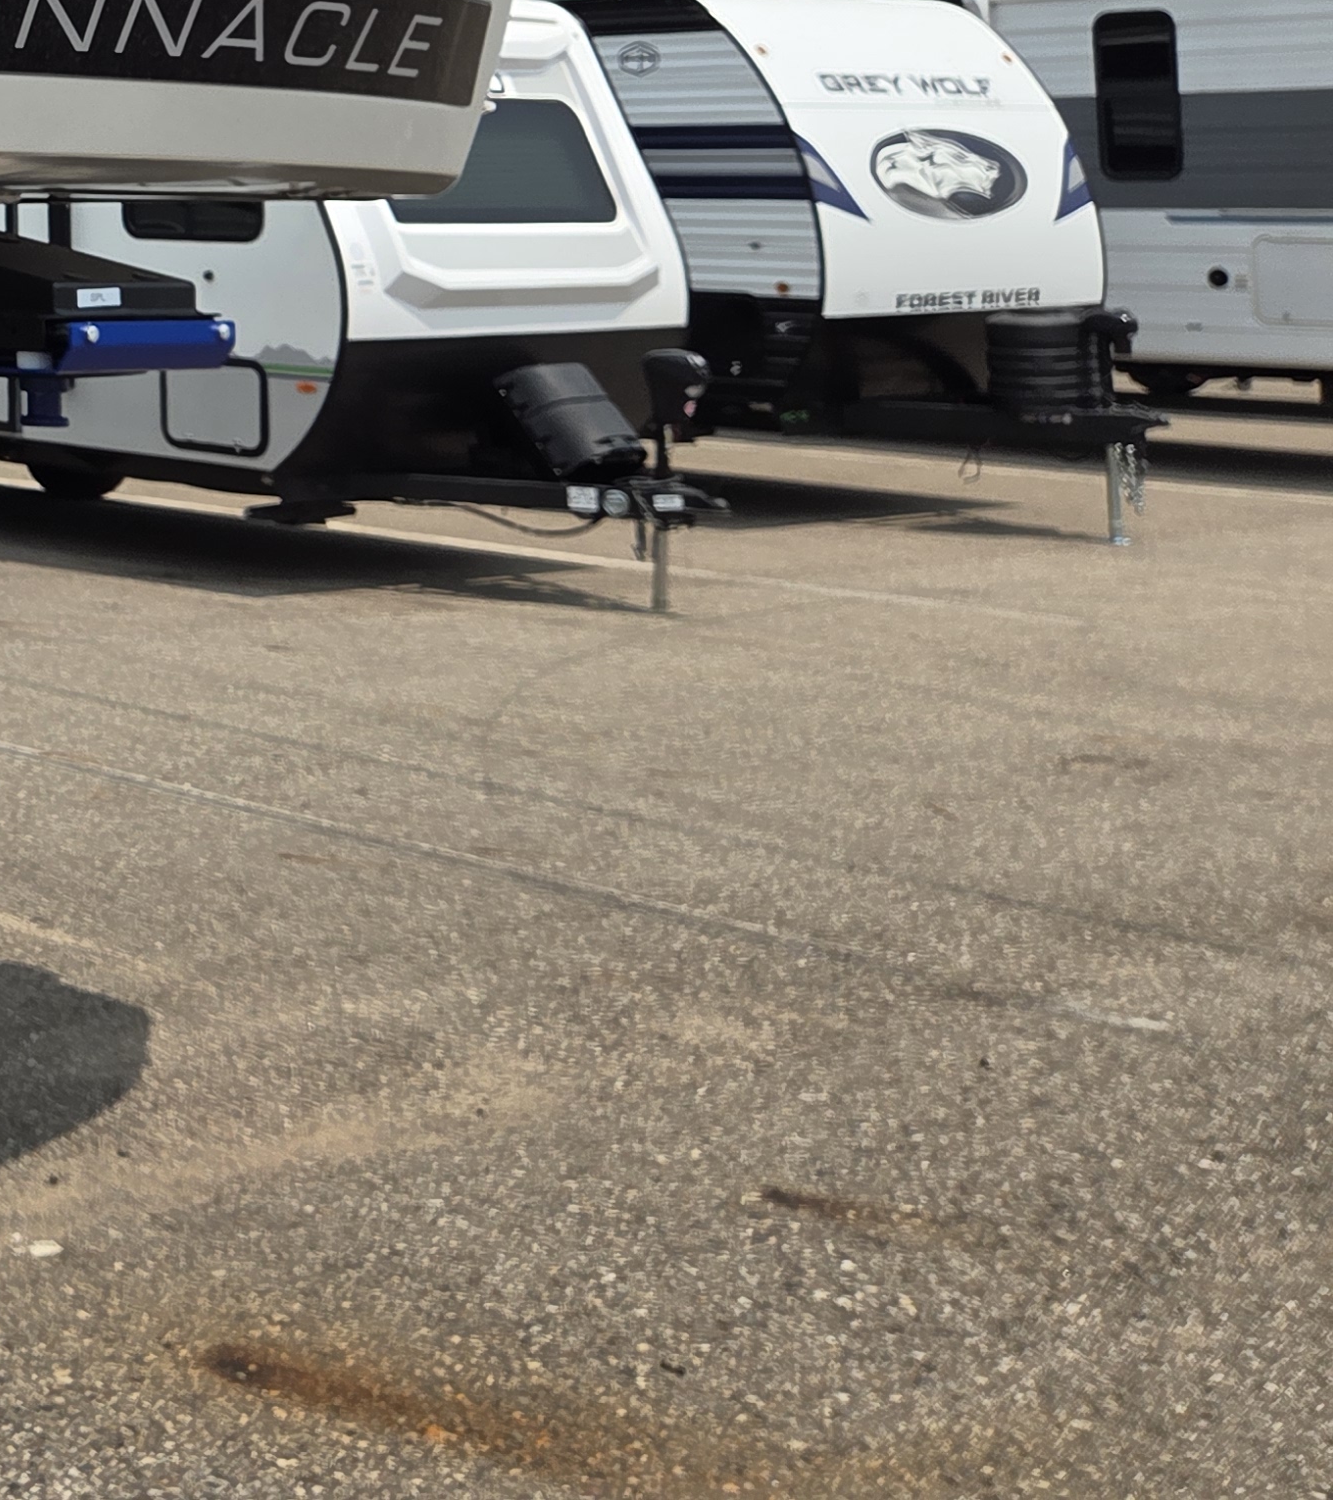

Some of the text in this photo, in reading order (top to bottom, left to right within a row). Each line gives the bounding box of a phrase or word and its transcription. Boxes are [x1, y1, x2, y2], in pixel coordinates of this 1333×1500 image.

[817, 73, 990, 98] GREY WOLF
[895, 287, 1041, 309] FOREST RIVER
